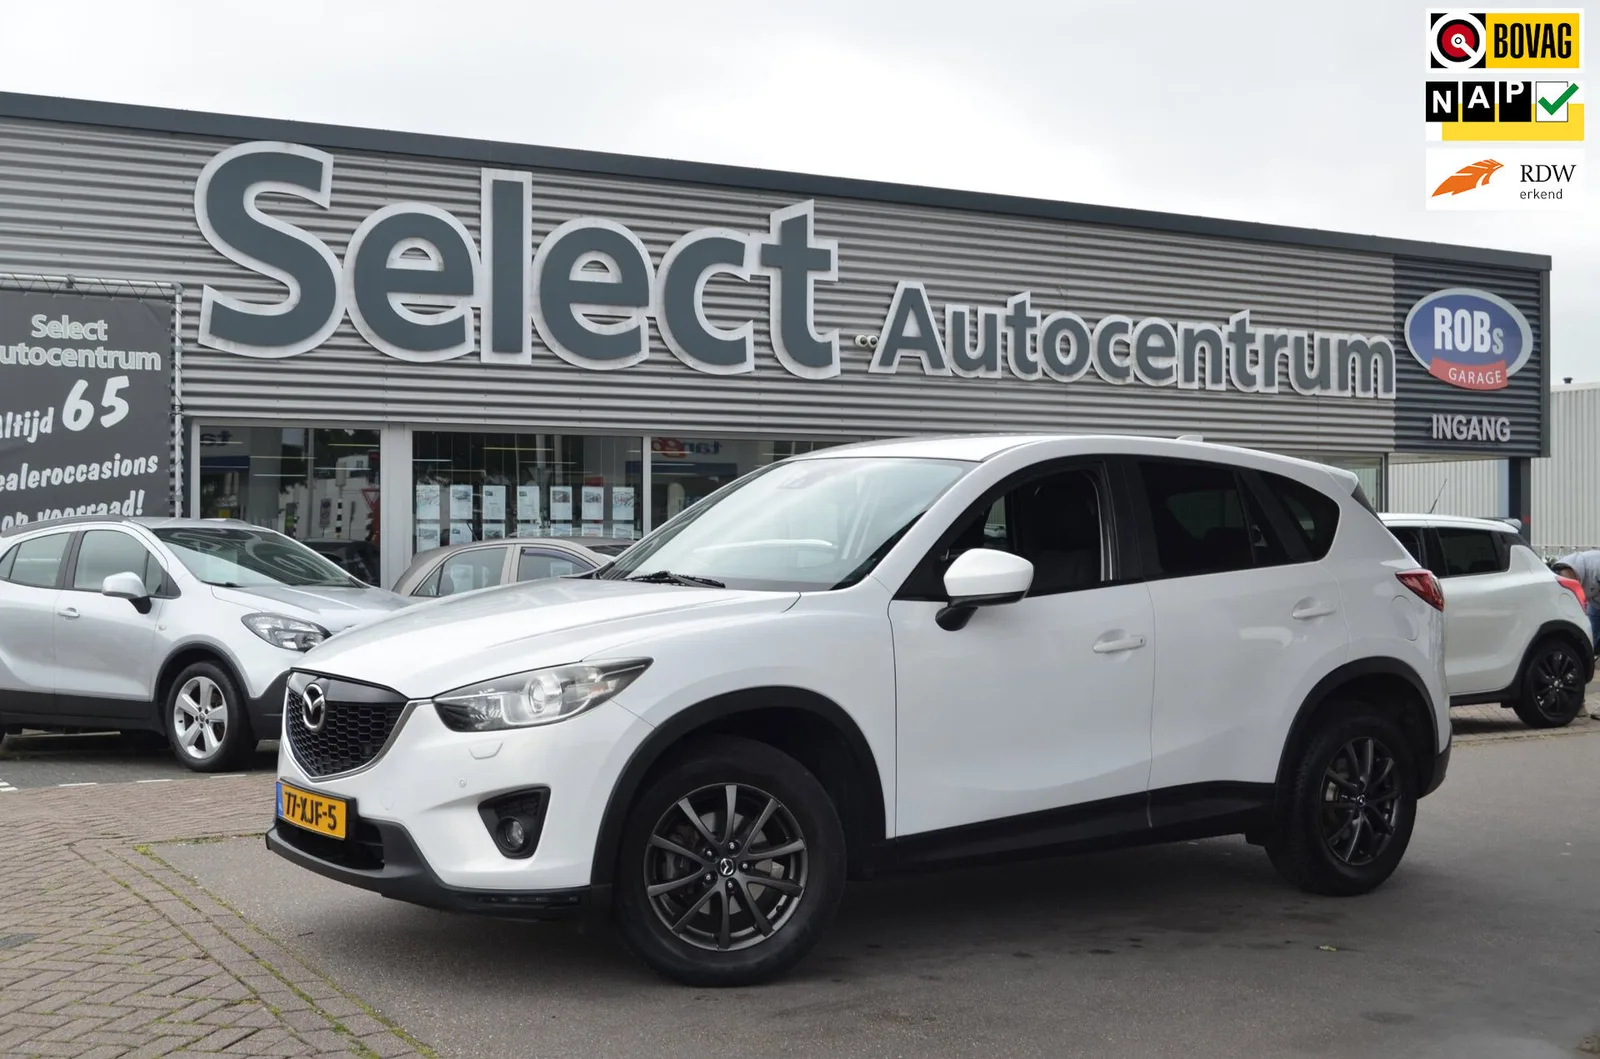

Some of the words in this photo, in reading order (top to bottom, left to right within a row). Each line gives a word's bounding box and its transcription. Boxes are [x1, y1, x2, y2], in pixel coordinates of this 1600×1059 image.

[194, 141, 842, 380] Select
[868, 280, 1396, 400] Autocentrum
[31, 313, 108, 341] Select
[1434, 307, 1504, 355] ROBs
[1448, 367, 1502, 385] GARAGE
[0, 406, 54, 443] ltijd
[62, 375, 130, 432] 65
[1432, 414, 1511, 442] INGANG
[285, 792, 337, 831] 77-XJF-5
